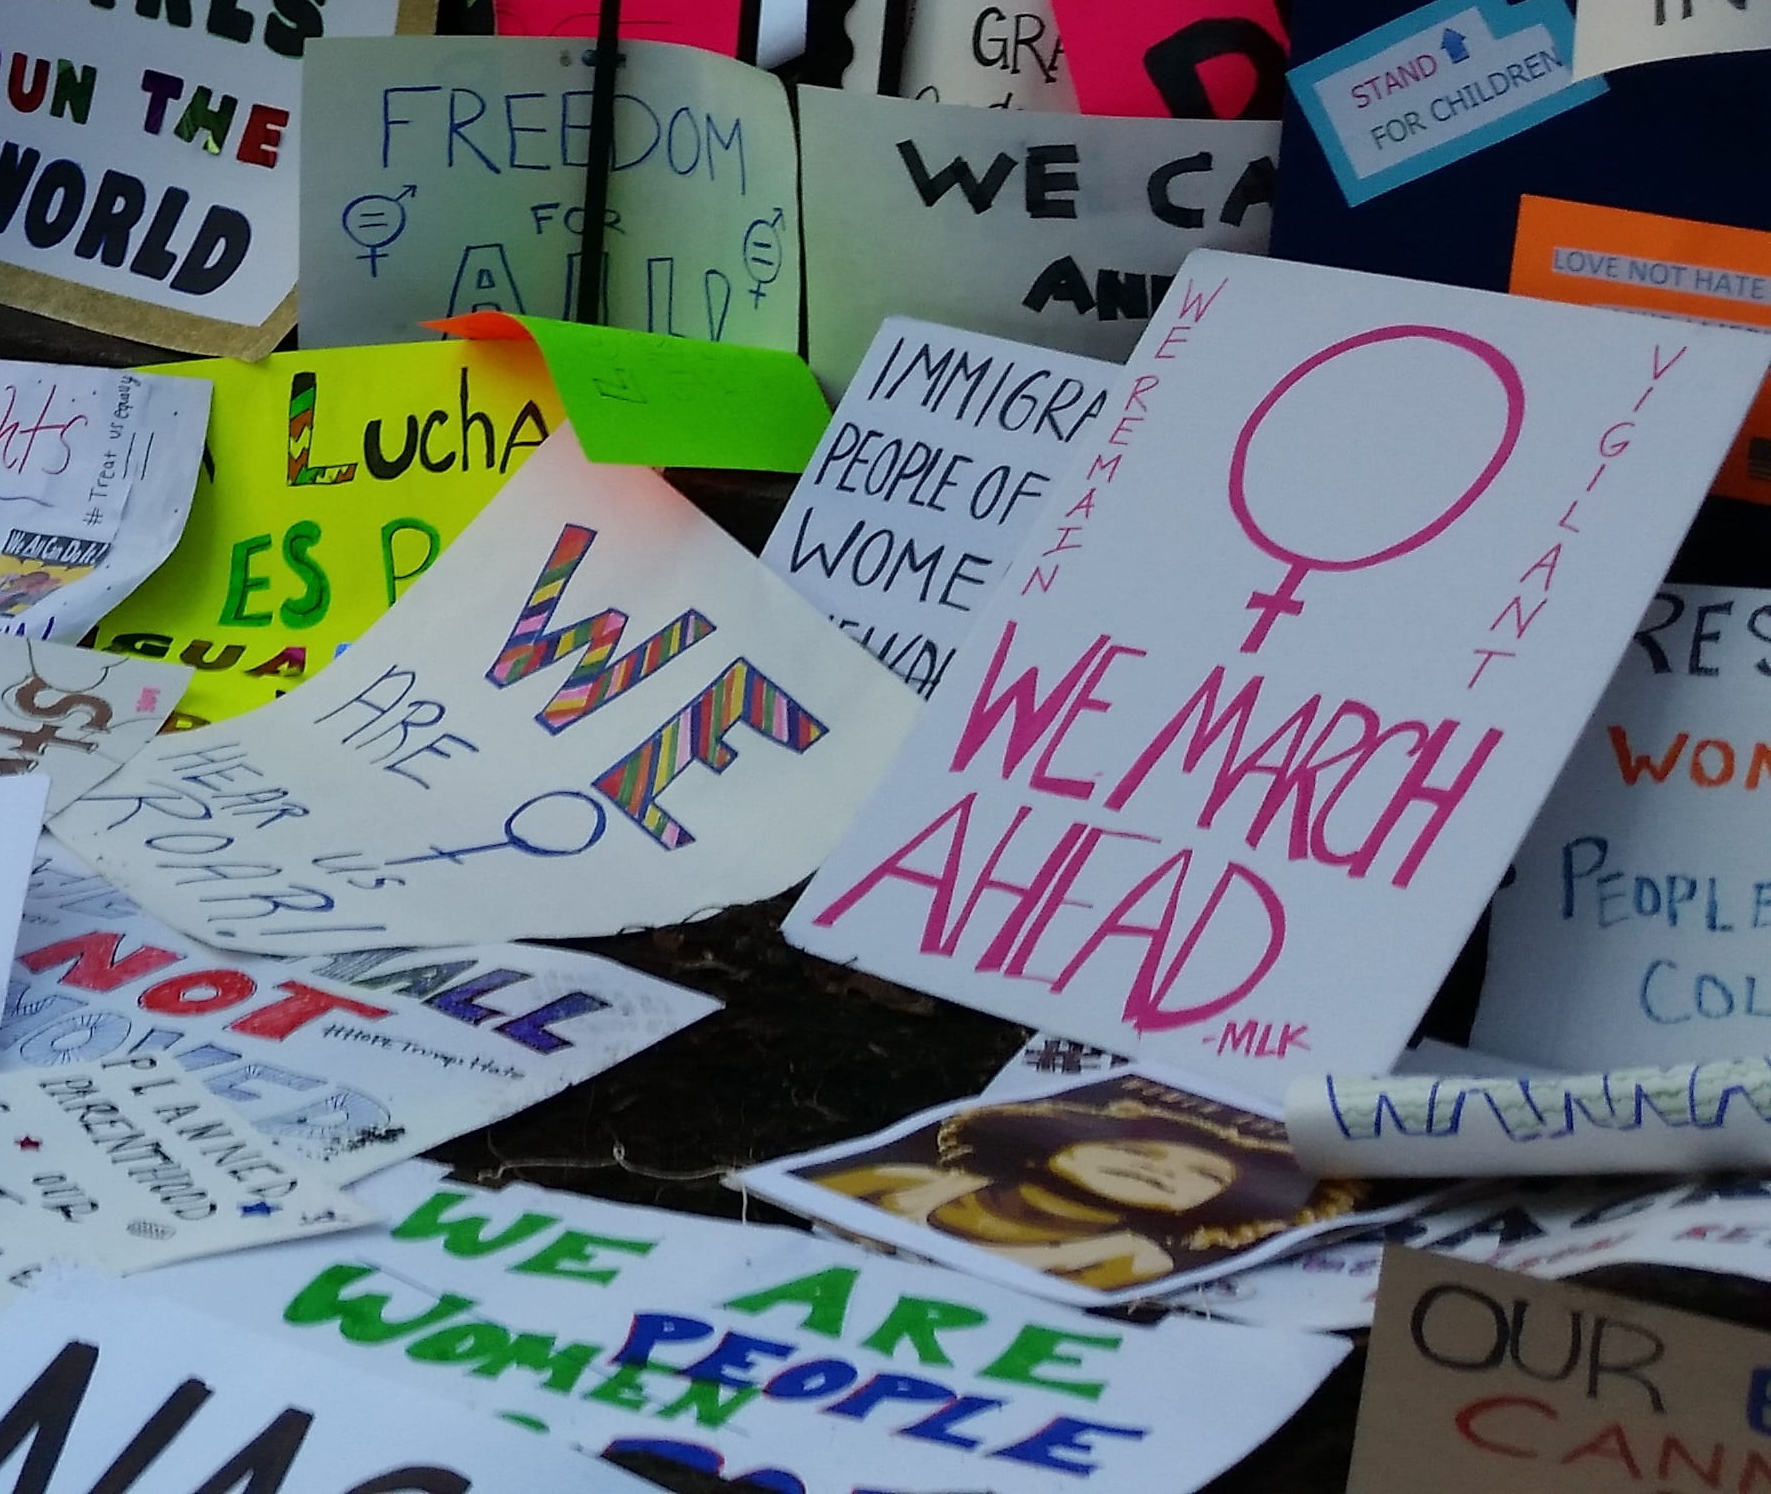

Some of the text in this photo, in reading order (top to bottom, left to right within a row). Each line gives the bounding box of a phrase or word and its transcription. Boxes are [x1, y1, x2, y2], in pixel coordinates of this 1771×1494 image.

[139, 68, 289, 171] THE
[1349, 53, 1438, 111] STAND
[1369, 45, 1566, 152] FOR CHILDREN
[896, 139, 1082, 221] WE
[1554, 251, 1765, 299] LOVE NOT HATE
[812, 422, 1051, 527] PEOPLE OF
[314, 662, 481, 790] ARE
[949, 620, 1504, 889] WE MARCH
[312, 851, 405, 896] US
[810, 792, 1288, 1032] AHEAD
[16, 931, 393, 1042] NOT
[101, 1052, 300, 1202] PLANNED
[389, 1192, 1131, 1403] WE ARE
[1409, 1280, 1664, 1415] OUR
